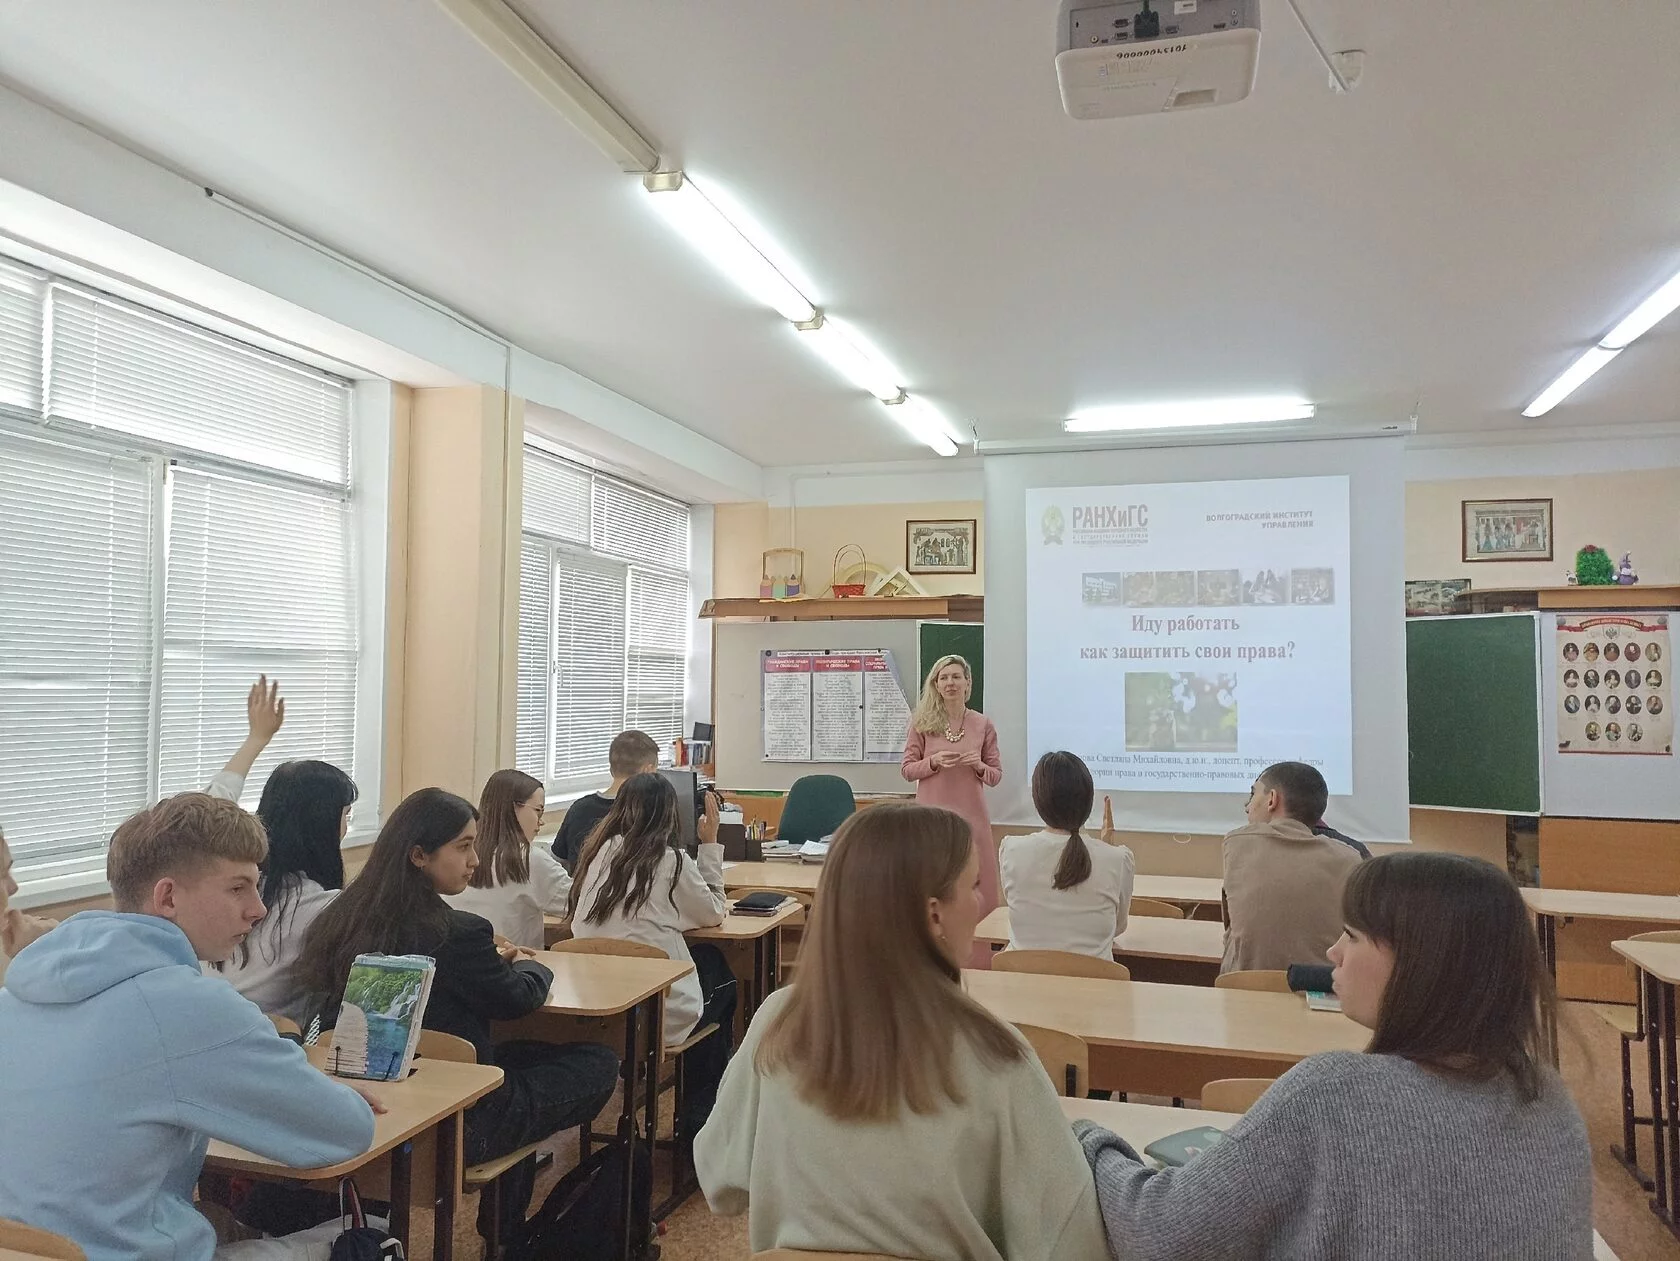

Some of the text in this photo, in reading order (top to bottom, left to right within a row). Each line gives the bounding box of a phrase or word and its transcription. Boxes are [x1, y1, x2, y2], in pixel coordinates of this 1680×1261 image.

[1072, 504, 1149, 528] РАНХиГС
[1206, 510, 1313, 522] ВОЛГОГРАДСКИЙ ИНСТИТУТ
[1262, 520, 1314, 529] УПРАВЛЕНИЯ
[1131, 614, 1241, 636] Иду работать
[1080, 641, 1296, 663] как защитить свои права?
[1096, 753, 1131, 763] Светлана
[1133, 753, 1183, 766] Михайловна,
[1091, 769, 1113, 778] еории
[1115, 769, 1136, 779] права
[1144, 769, 1245, 781] государственно-правовых
